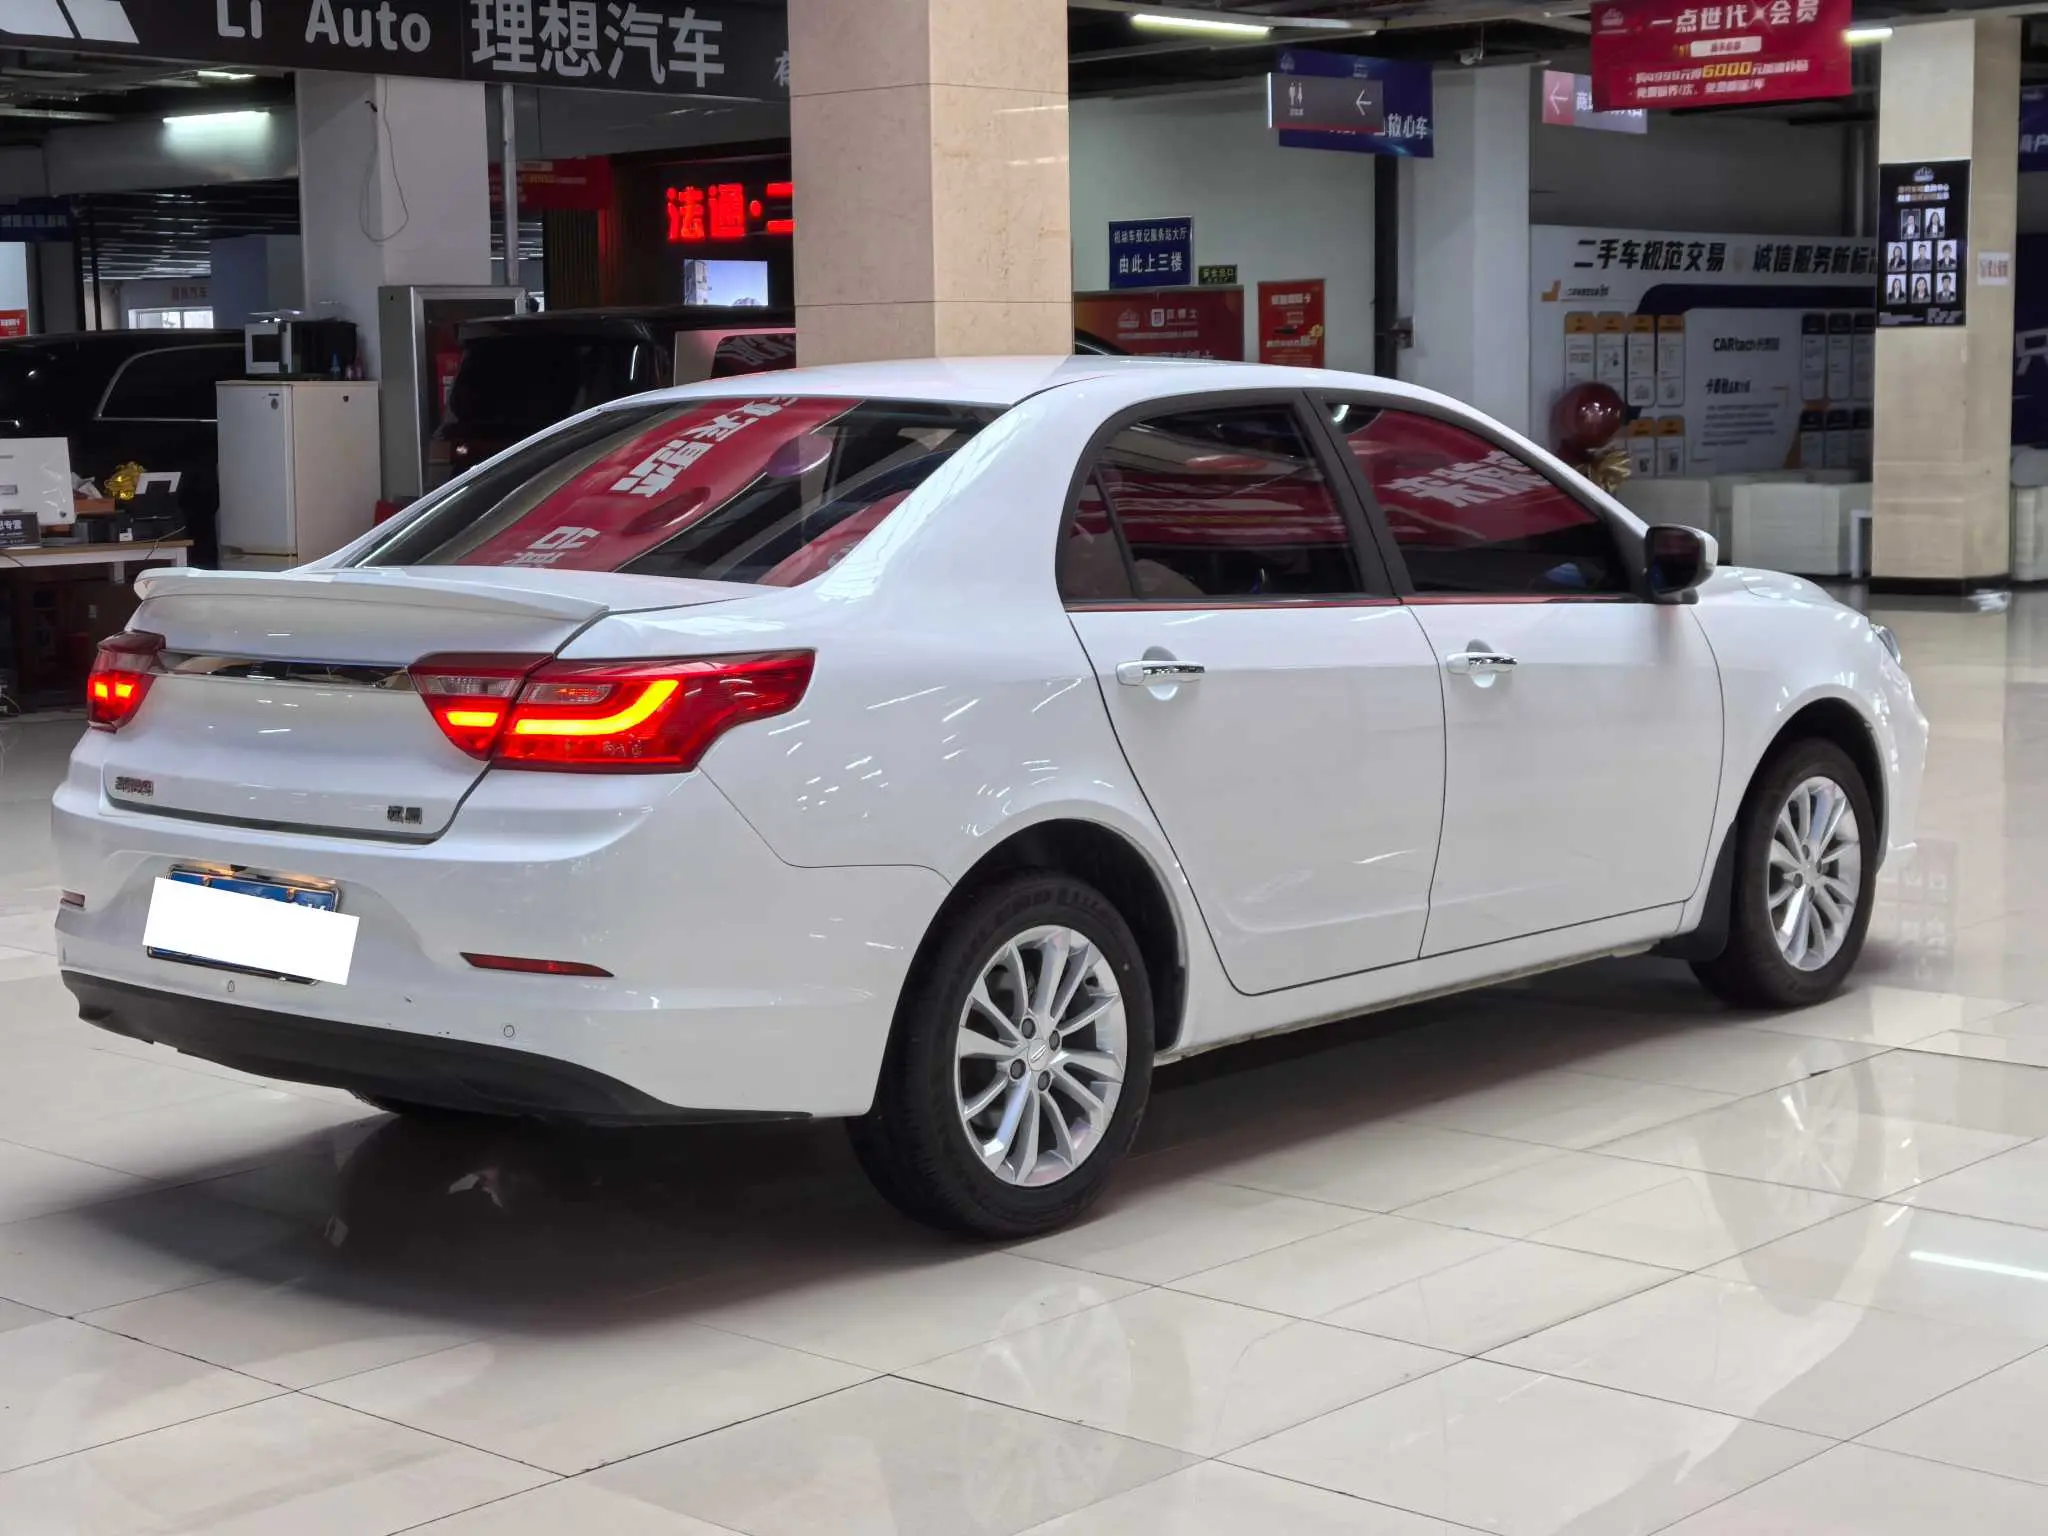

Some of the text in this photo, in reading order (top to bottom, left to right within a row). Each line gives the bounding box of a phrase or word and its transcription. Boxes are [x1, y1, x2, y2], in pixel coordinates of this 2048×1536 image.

[217, 0, 431, 52] Li Auto
[471, 0, 724, 88] 理想汽车
[1119, 251, 1182, 273] 由此上三楼
[1574, 240, 1726, 272] 二手车规范交易
